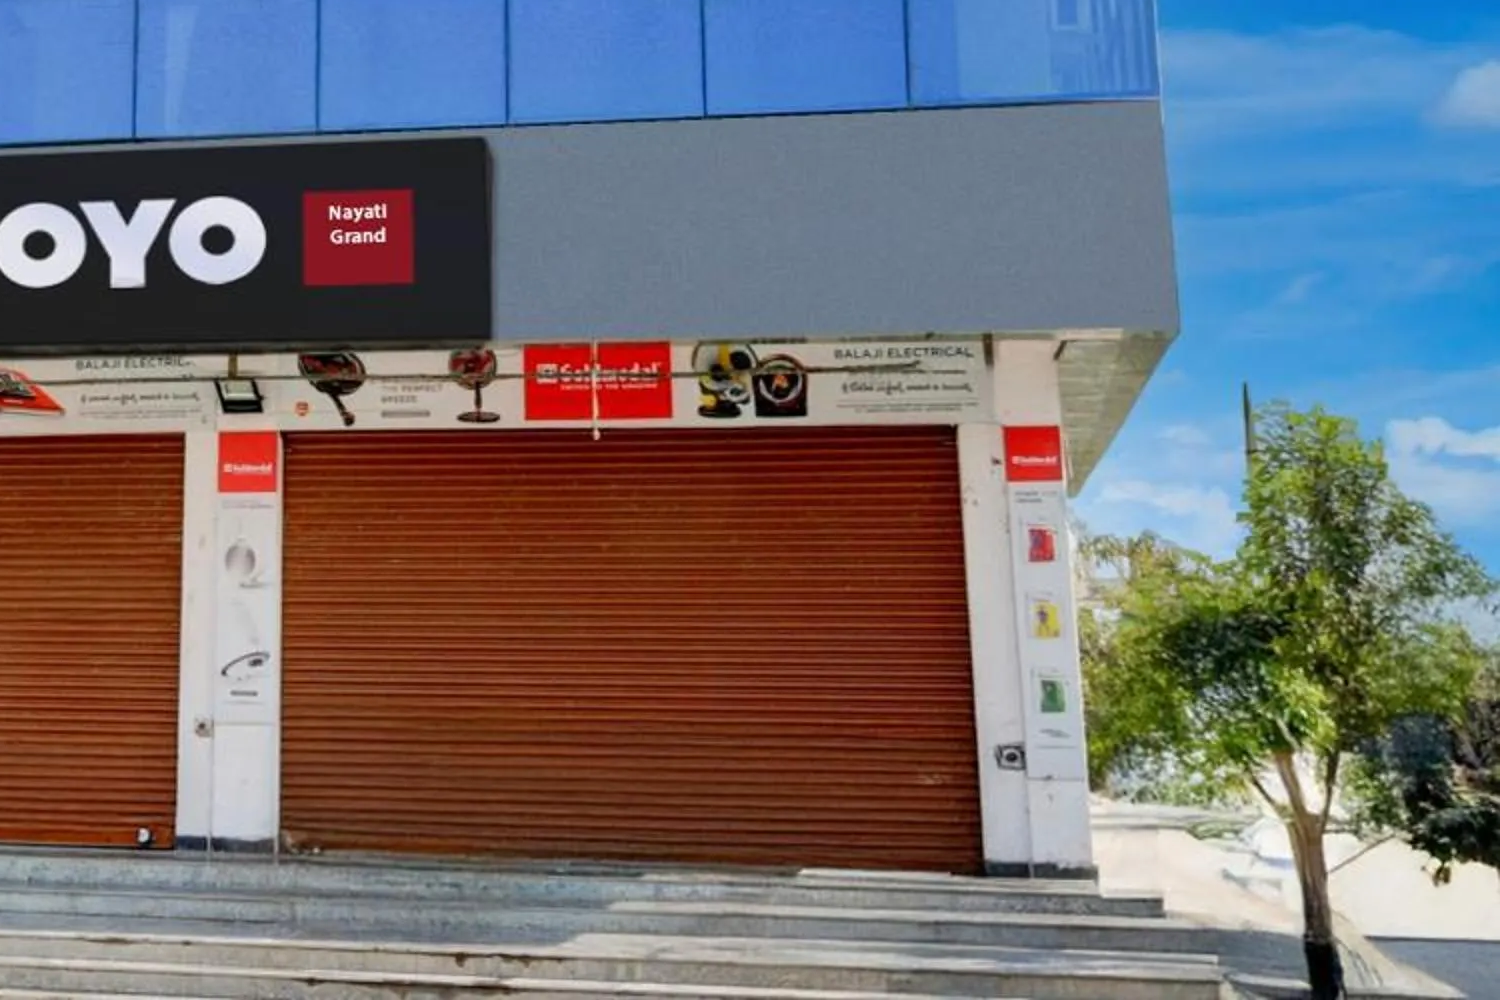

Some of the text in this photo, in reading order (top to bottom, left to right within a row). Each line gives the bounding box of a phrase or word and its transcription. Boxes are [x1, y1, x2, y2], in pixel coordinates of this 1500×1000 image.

[328, 202, 388, 224] Nayati
[329, 226, 387, 245] Grand
[834, 345, 975, 360] BALAJI ELECTRICAL
[75, 358, 121, 370] BALAJI
